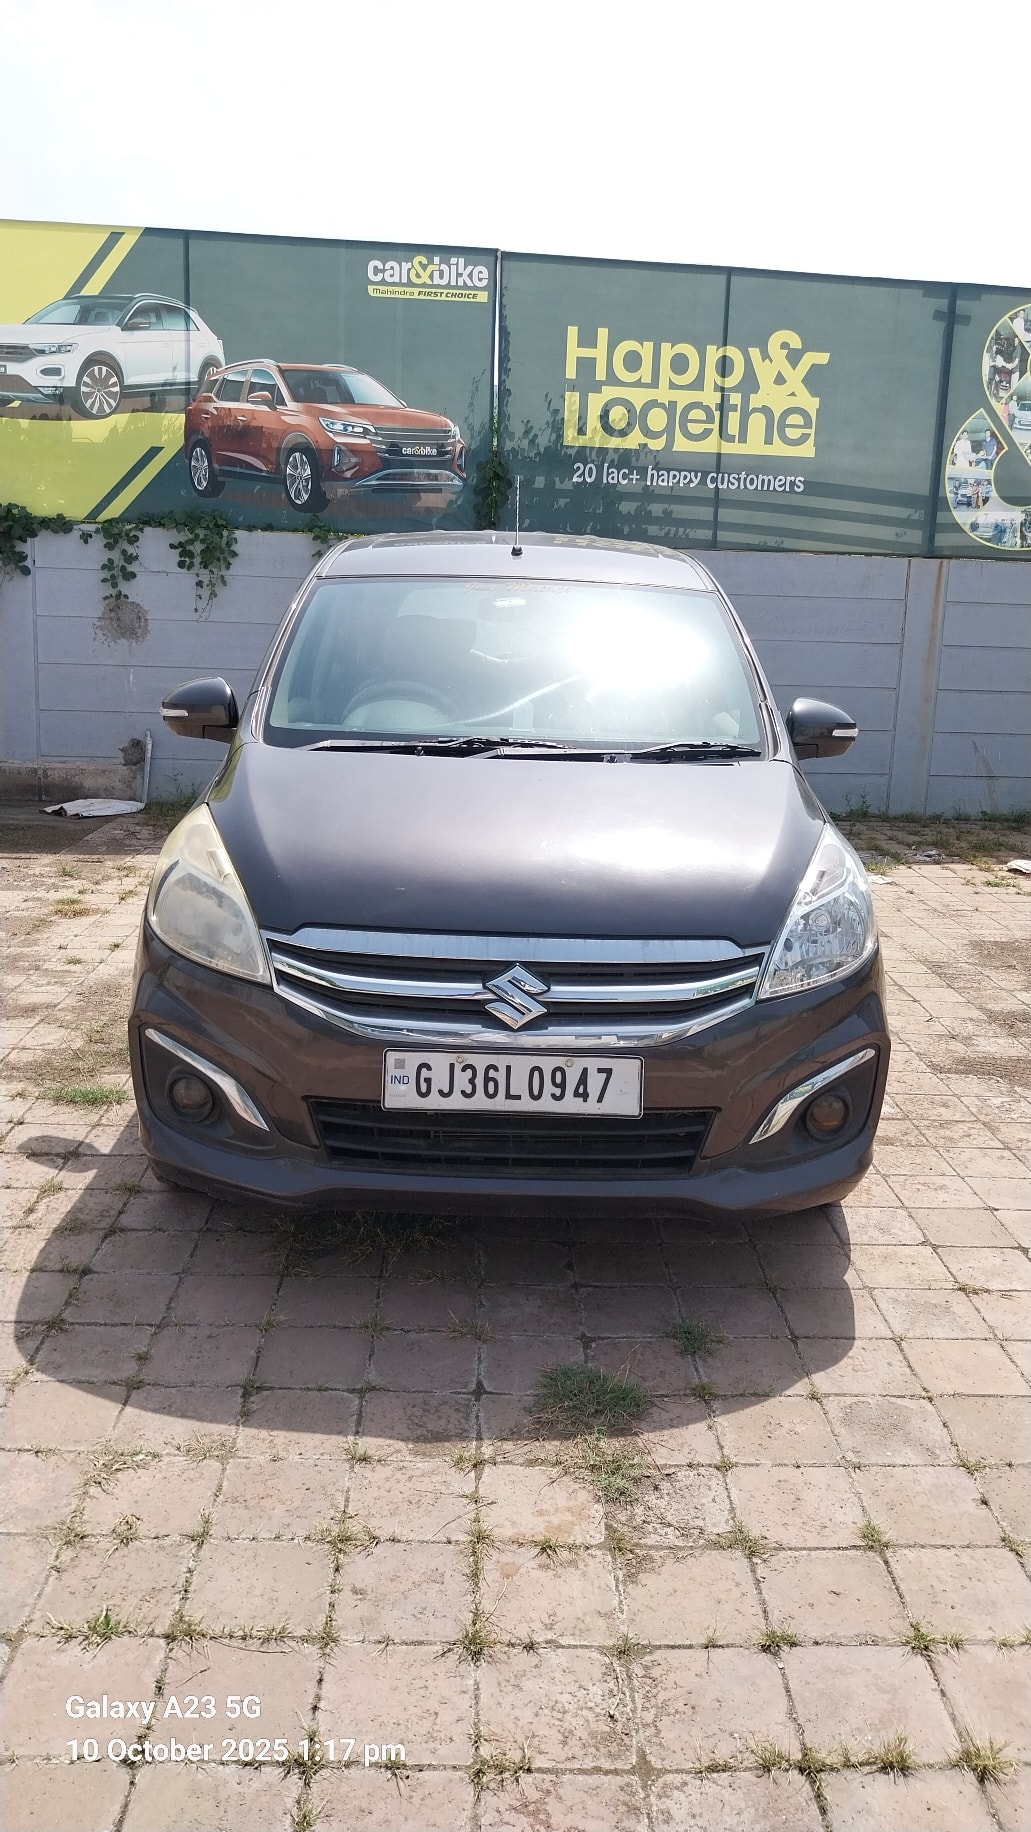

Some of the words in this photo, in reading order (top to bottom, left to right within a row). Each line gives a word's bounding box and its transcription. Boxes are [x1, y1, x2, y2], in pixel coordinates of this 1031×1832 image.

[367, 256, 489, 287] car&bike
[417, 290, 444, 298] FIRST
[445, 292, 479, 300] CHOICE
[401, 445, 438, 456] car&bike
[572, 463, 596, 483] 20
[603, 464, 640, 485] lac+
[647, 466, 701, 488] happy
[706, 471, 805, 493] customers
[390, 1075, 410, 1085] IND
[415, 1062, 613, 1103] GJ36L0947
